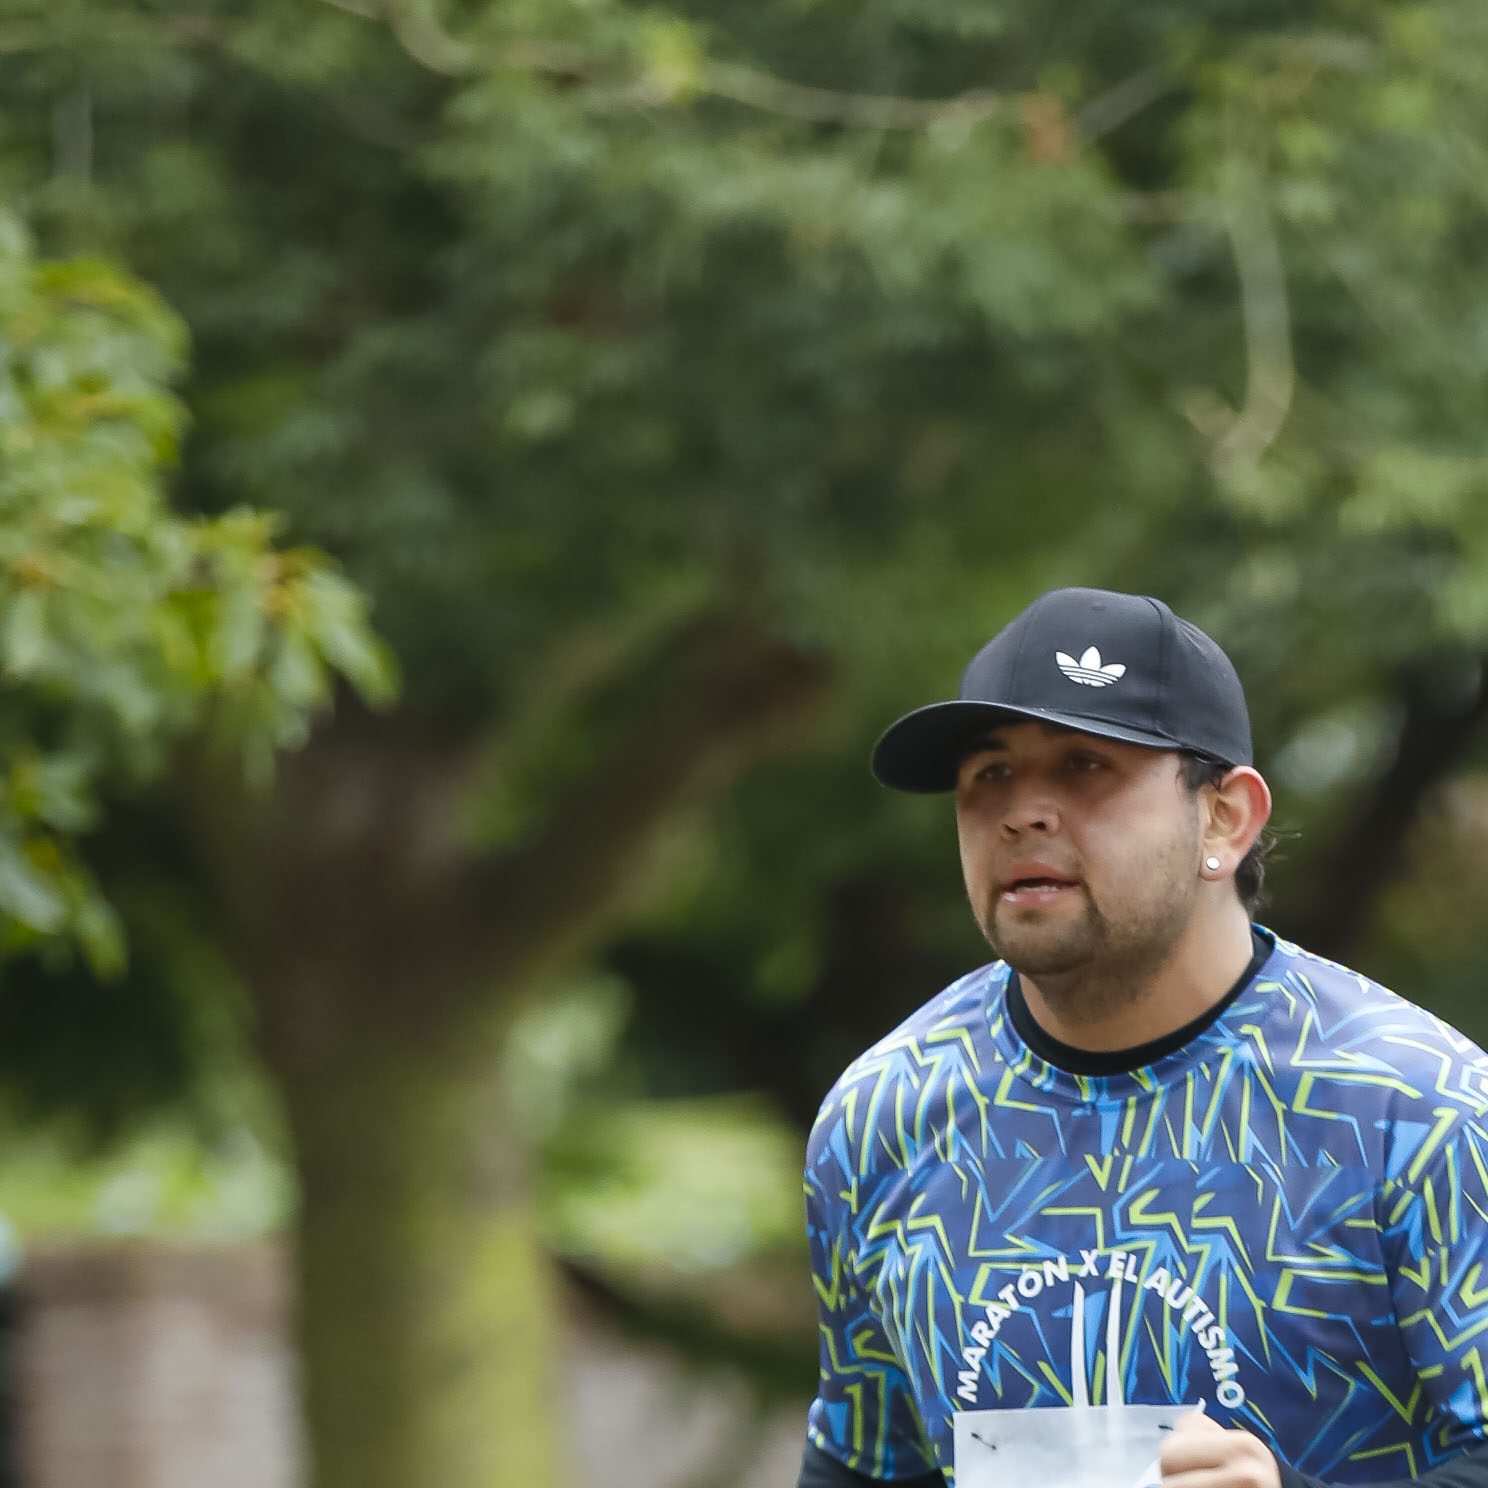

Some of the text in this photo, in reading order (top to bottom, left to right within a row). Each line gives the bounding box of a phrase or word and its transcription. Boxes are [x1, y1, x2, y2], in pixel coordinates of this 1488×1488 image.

[956, 1249, 1245, 1409] MARATÓN X EL AUTISMO
